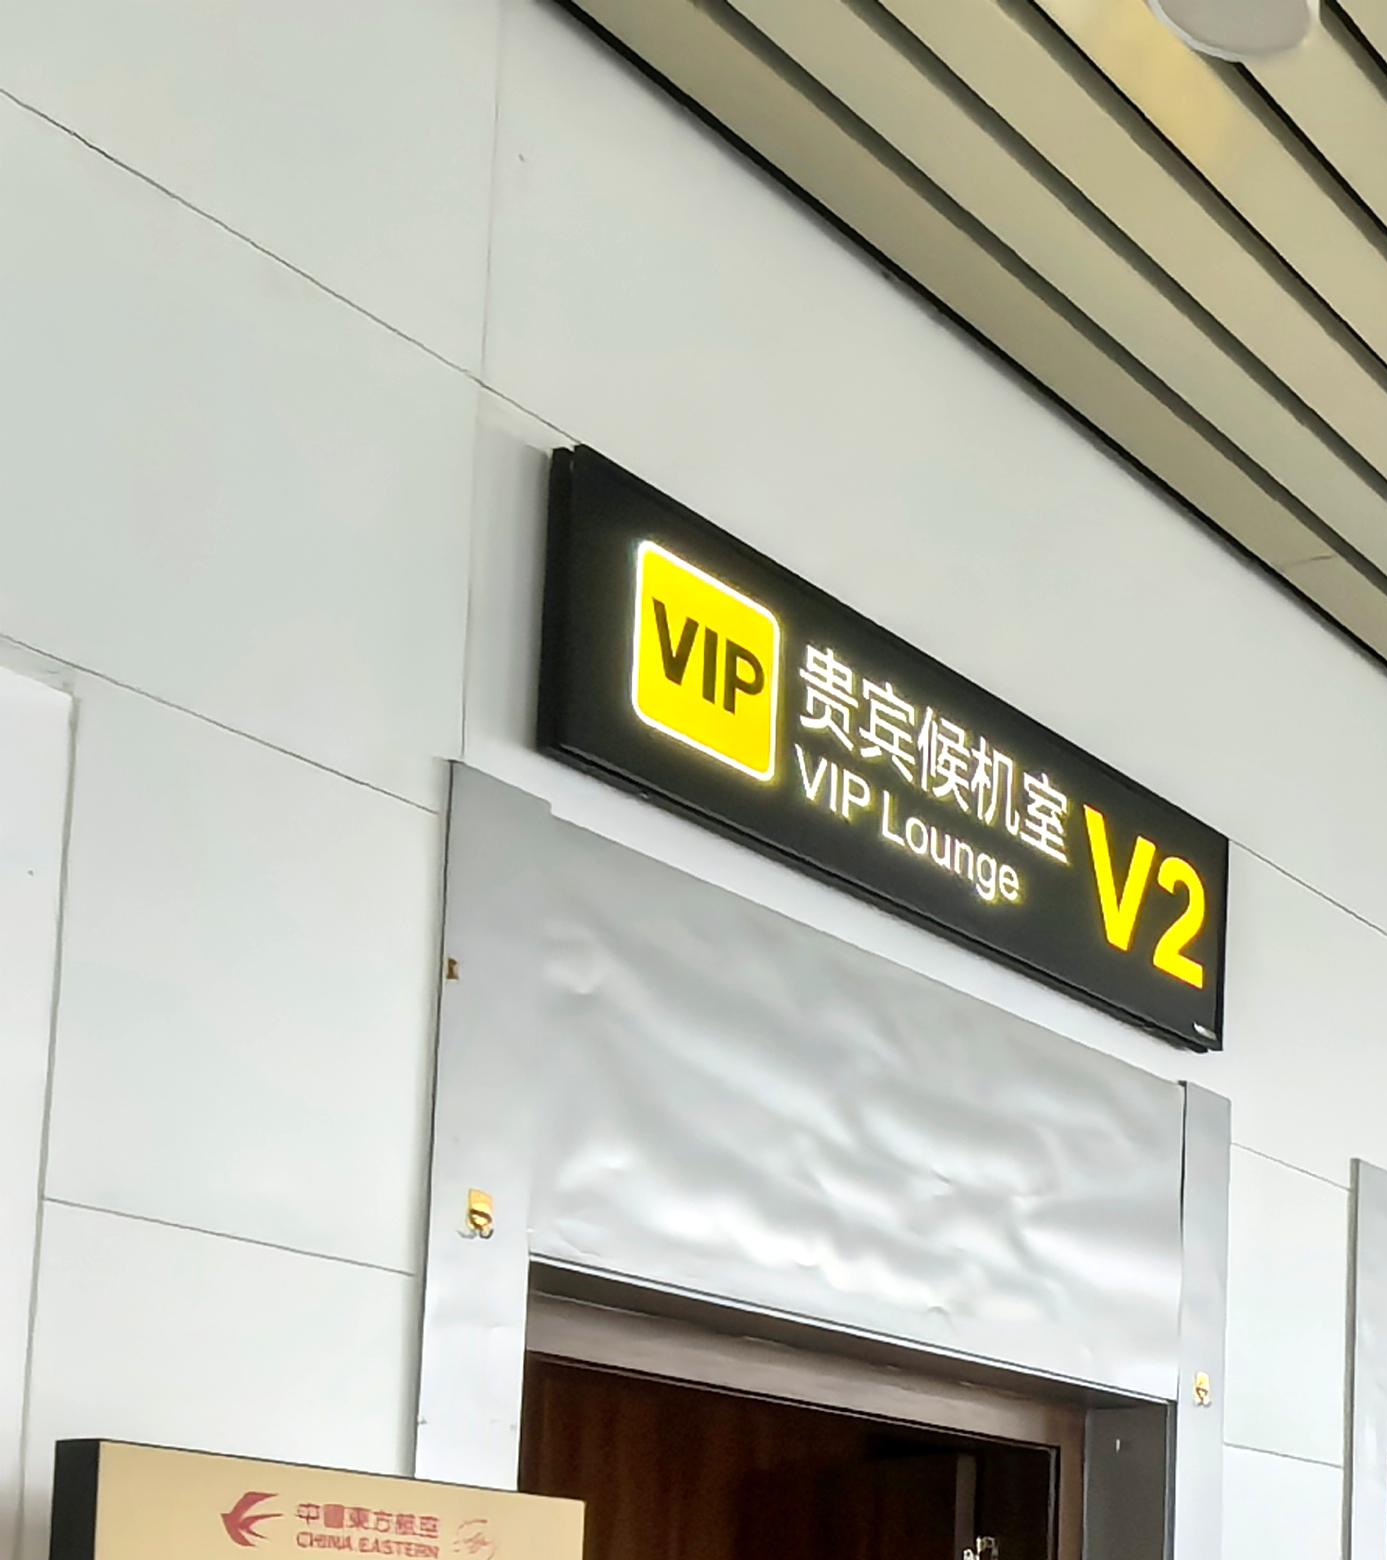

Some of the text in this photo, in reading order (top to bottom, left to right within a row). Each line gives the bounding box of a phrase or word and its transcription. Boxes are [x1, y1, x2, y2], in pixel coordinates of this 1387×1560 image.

[652, 597, 765, 715] VIP
[794, 743, 1021, 902] VIP Lounge
[799, 644, 1070, 864] 贵宾候机室
[1083, 803, 1204, 989] V2
[297, 1531, 440, 1559] CHINA EASTERN
